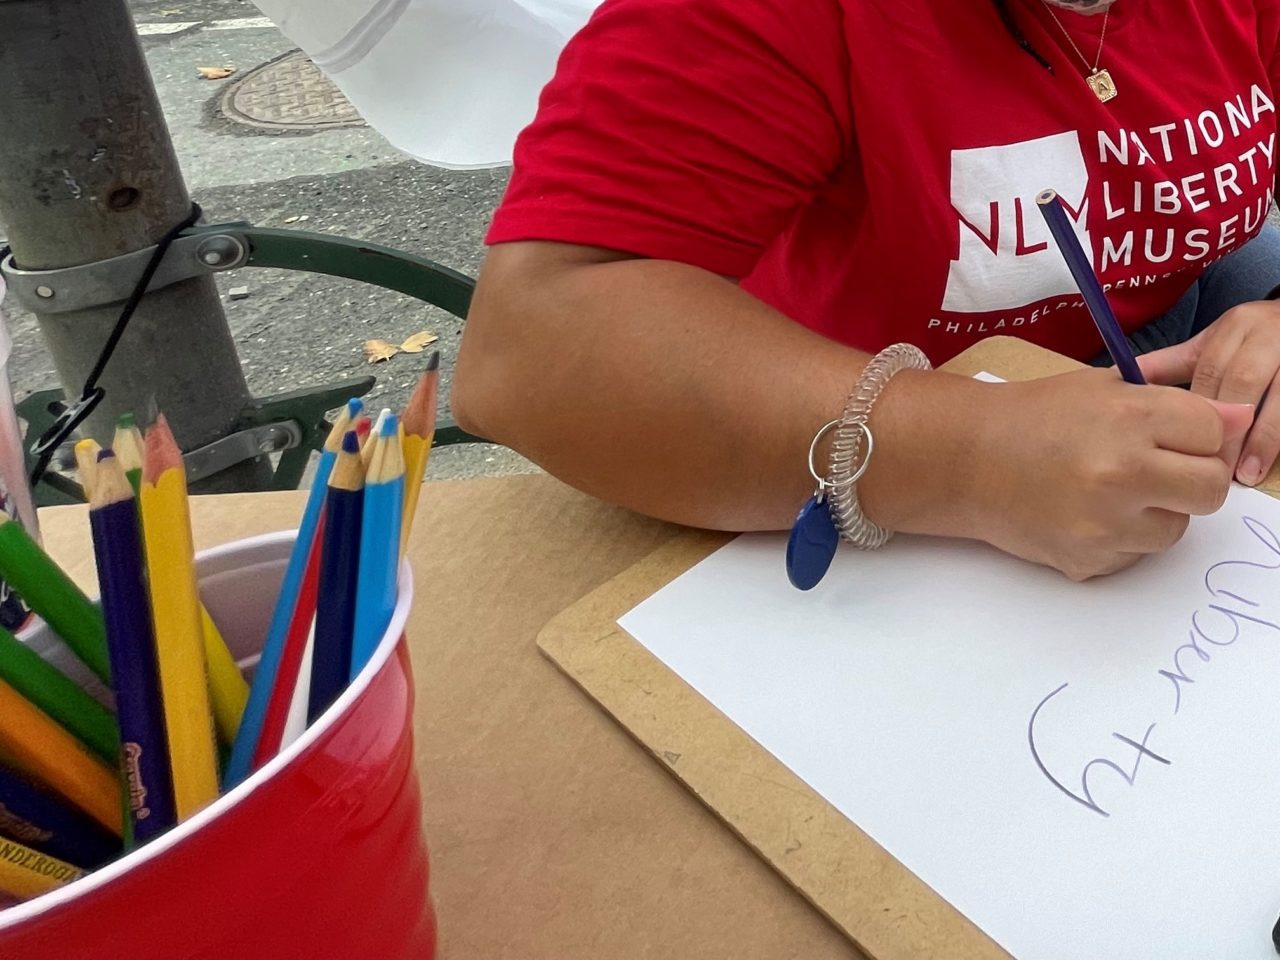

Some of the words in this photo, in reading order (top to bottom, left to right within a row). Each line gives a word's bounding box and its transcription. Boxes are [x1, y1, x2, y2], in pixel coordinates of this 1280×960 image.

[1098, 83, 1275, 165] NATIONA
[1103, 132, 1275, 221] LIBERTY
[927, 300, 1087, 334] PHILADELPH
